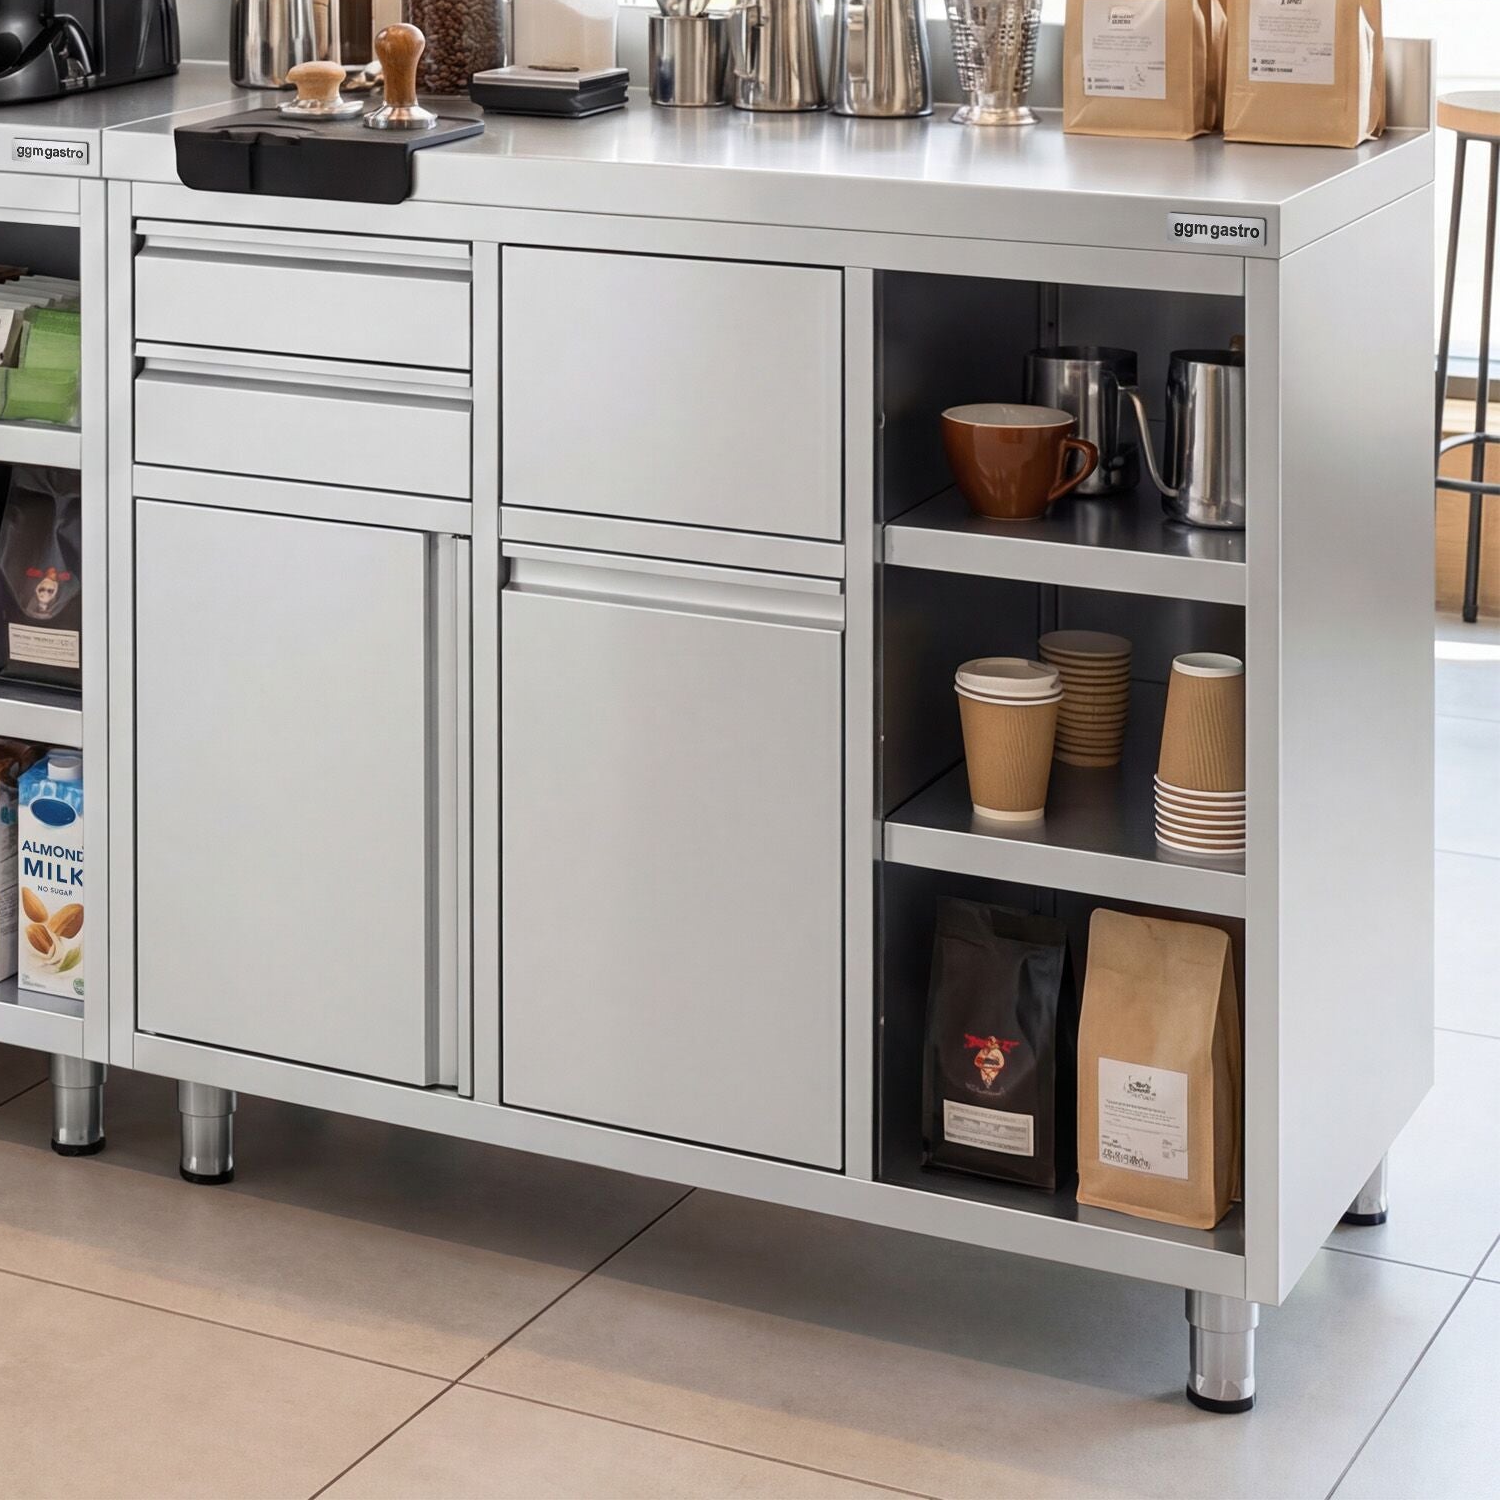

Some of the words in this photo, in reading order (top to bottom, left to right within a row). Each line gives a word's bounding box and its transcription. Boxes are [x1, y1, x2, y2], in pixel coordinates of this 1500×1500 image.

[21, 839, 84, 863] ALMOND
[24, 857, 84, 888] MILK
[37, 884, 49, 893] NO
[50, 887, 73, 897] SUGAR
